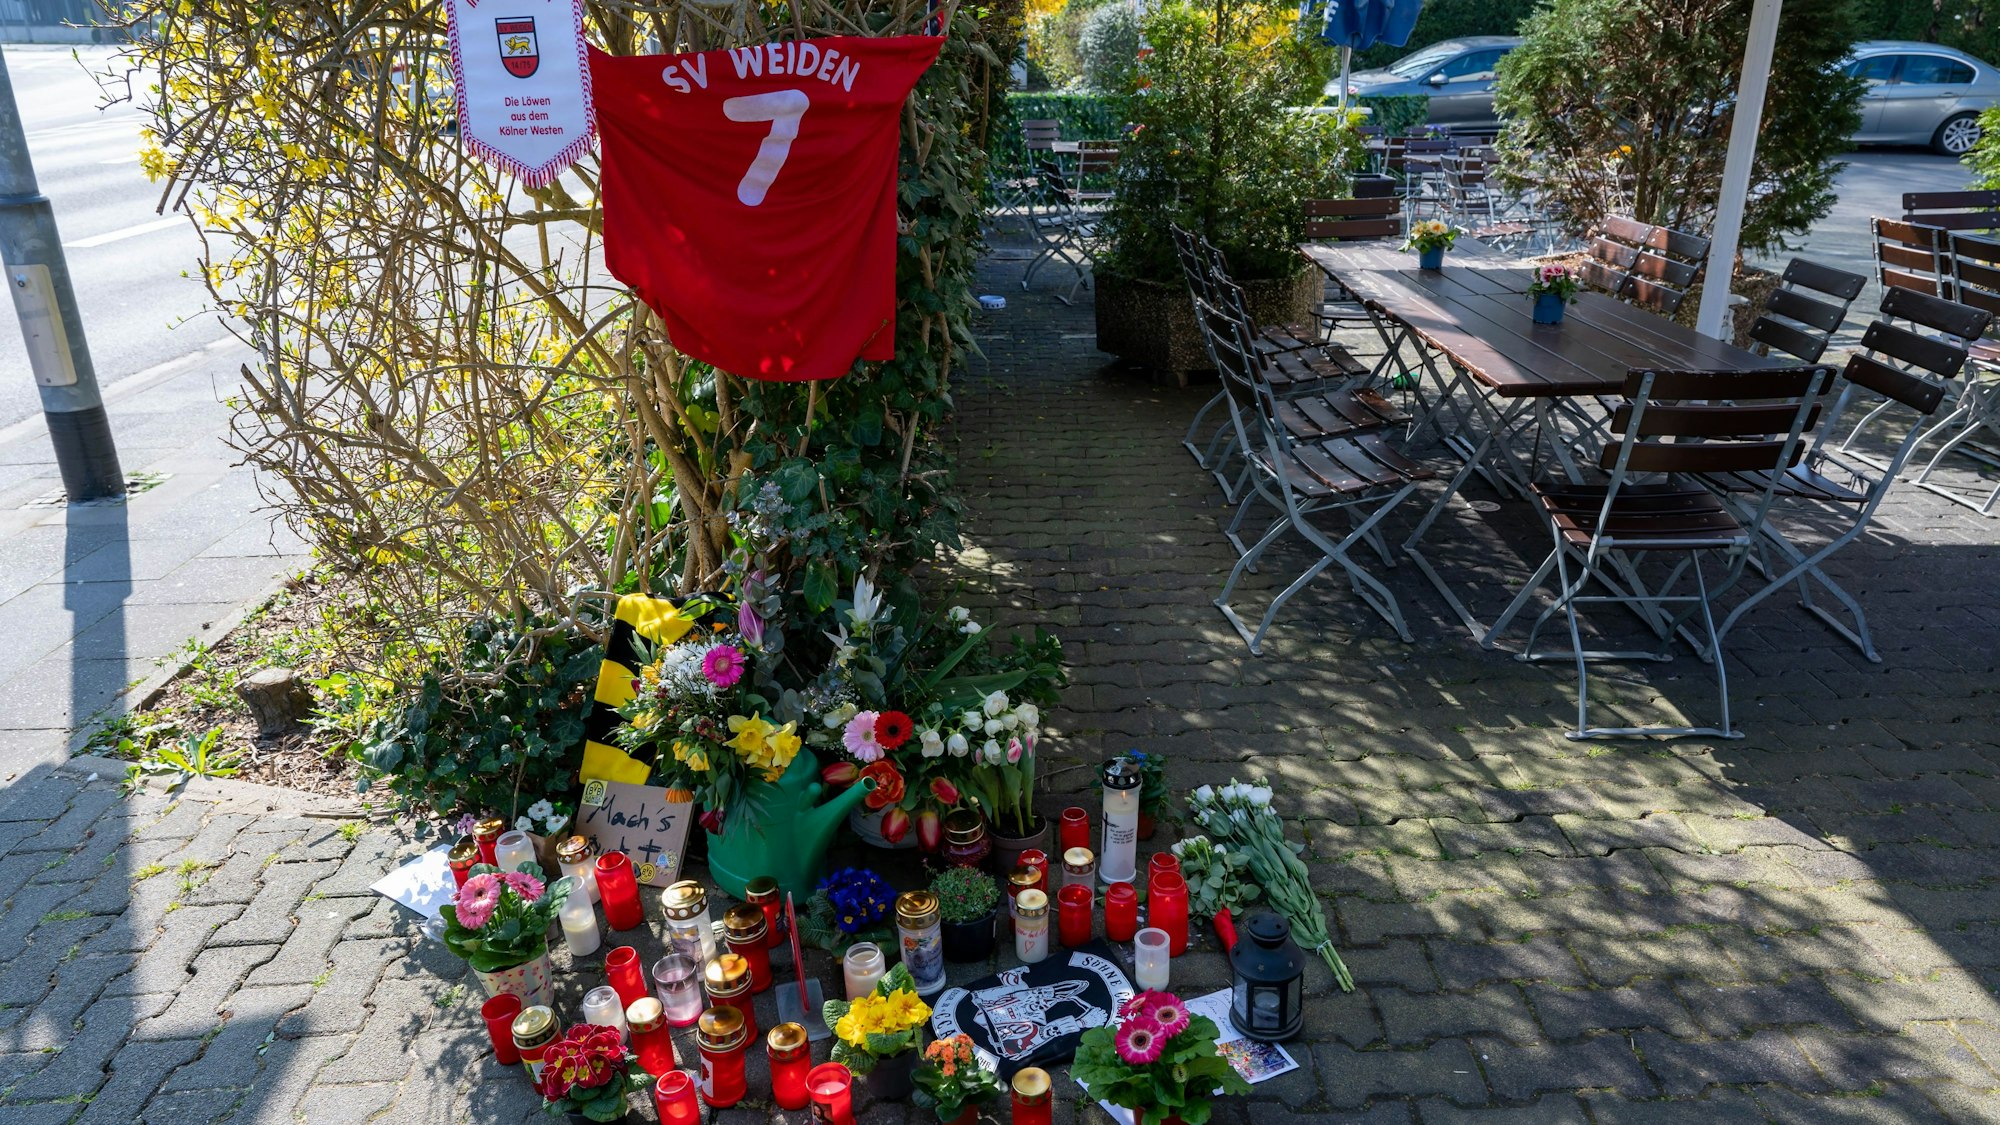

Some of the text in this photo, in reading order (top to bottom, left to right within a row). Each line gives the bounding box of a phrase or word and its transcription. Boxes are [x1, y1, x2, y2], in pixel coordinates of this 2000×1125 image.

[661, 42, 861, 94] SV WEIDEN
[504, 96, 551, 107] Die Löwen
[510, 111, 549, 121] aus dem
[499, 126, 564, 136] Kölner Westen
[722, 89, 810, 207] 7
[1081, 955, 1123, 987] SÖHNE
